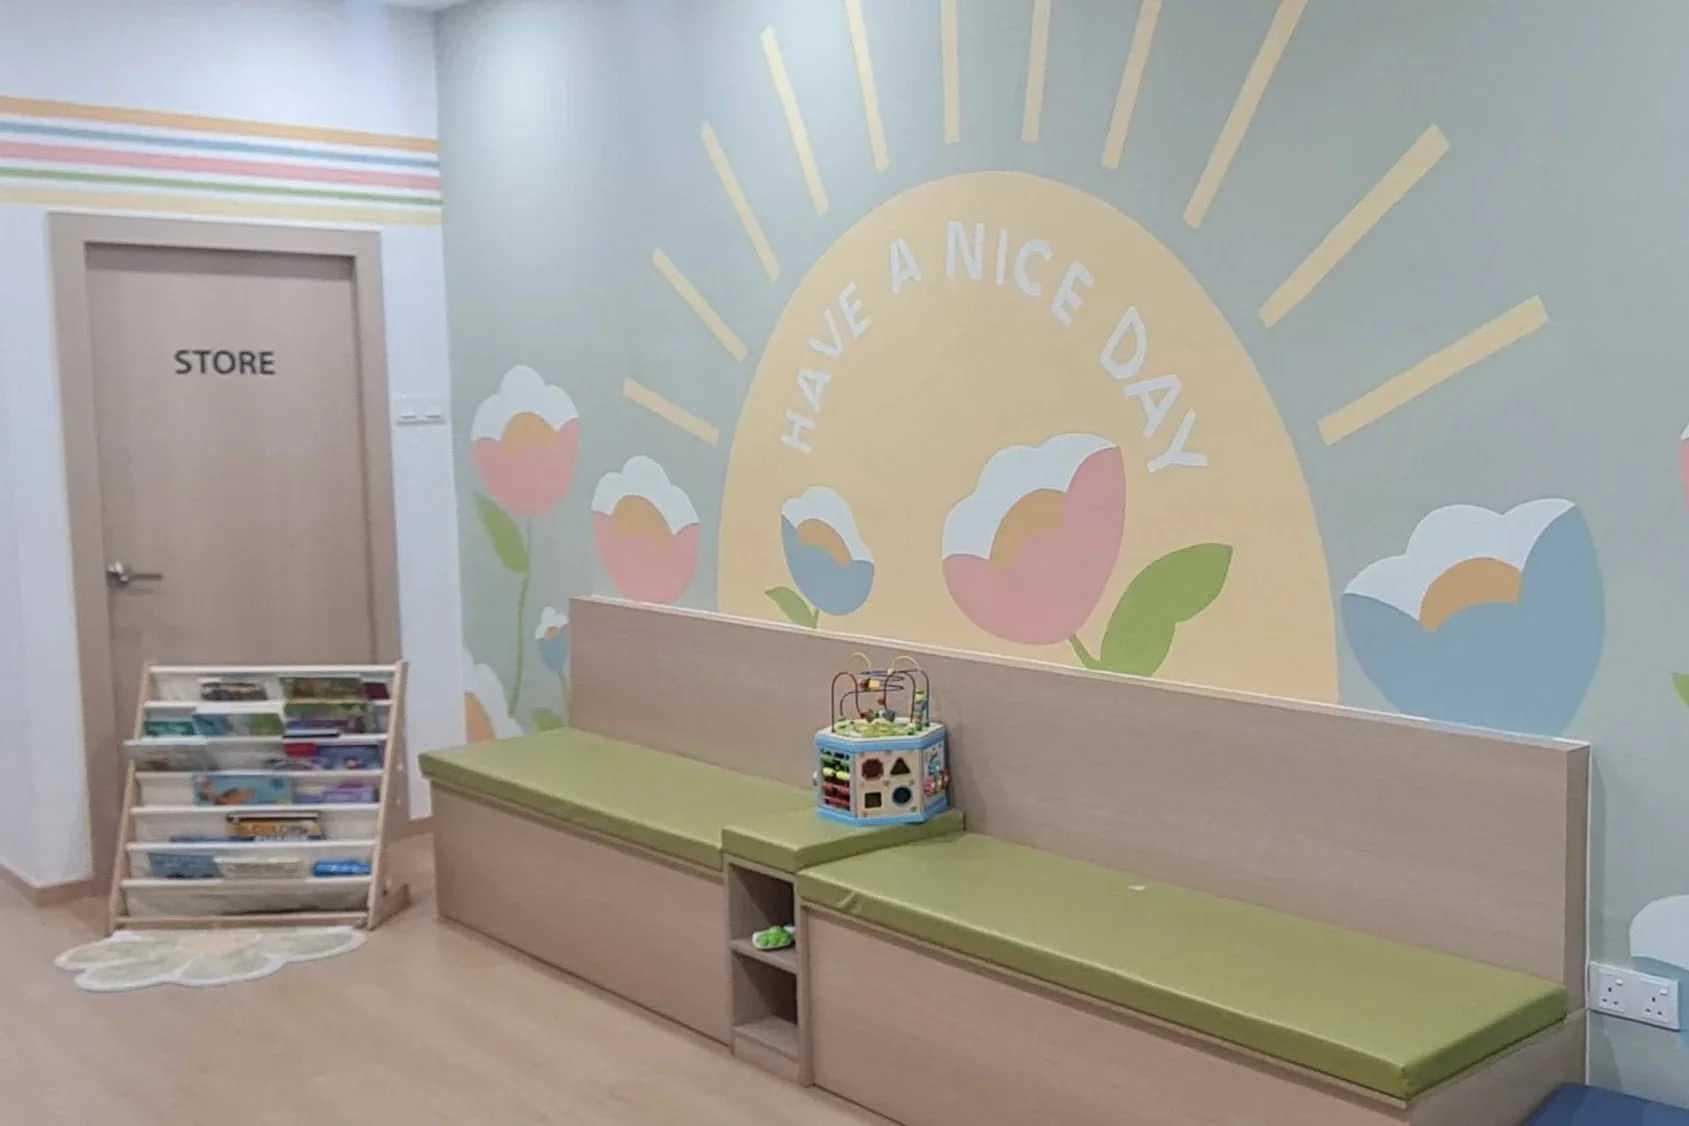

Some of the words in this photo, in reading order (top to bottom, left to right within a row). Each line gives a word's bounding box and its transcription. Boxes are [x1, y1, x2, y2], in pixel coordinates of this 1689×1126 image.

[174, 350, 276, 375] STORE
[781, 280, 871, 454] HAVE
[890, 237, 922, 294] A
[946, 221, 1095, 328] NICE
[1100, 306, 1208, 473] DAY
